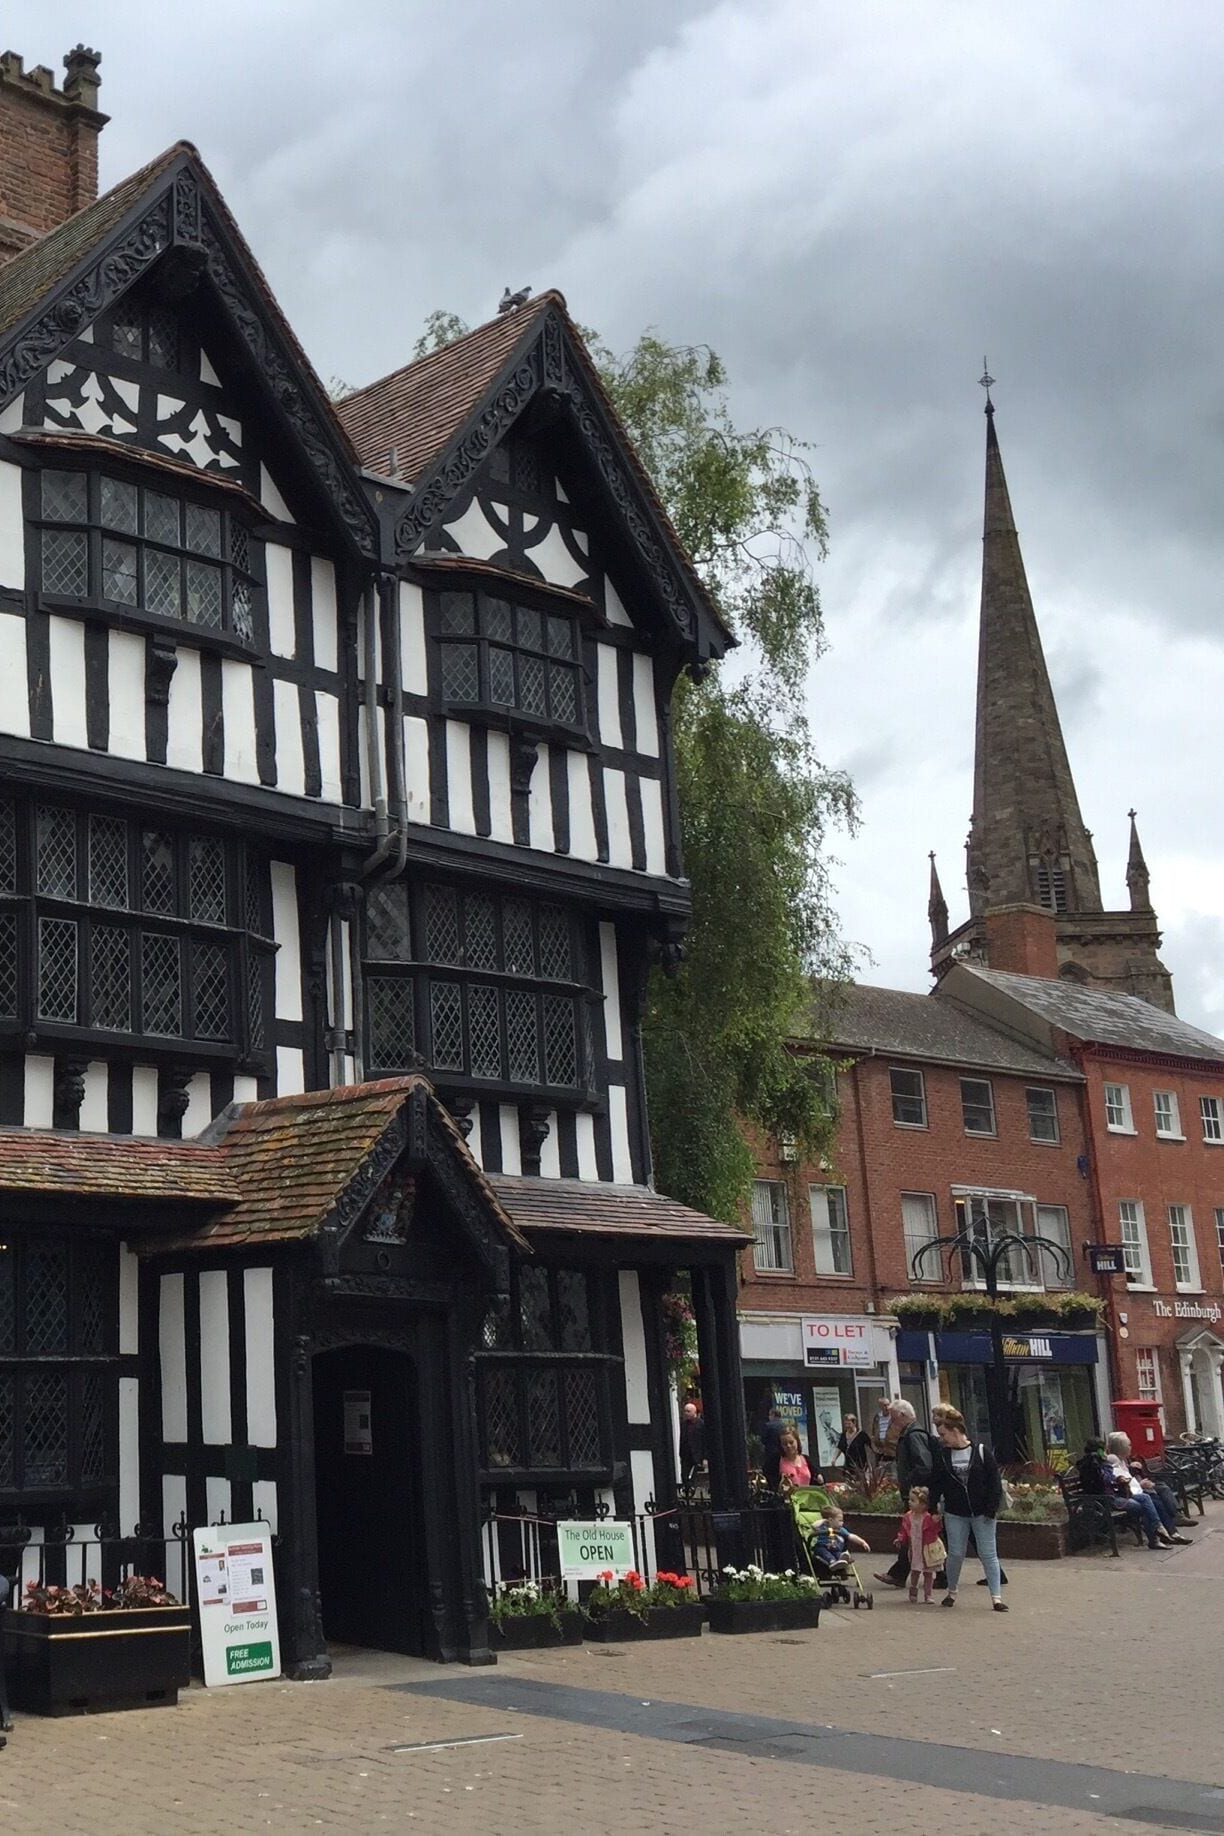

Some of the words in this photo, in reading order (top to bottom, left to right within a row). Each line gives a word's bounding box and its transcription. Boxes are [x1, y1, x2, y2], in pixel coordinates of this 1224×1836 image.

[1097, 1260, 1117, 1271] HILL
[1153, 1300, 1172, 1317] The
[1174, 1302, 1222, 1323] Edinburgh
[807, 1324, 829, 1337] TO
[835, 1325, 865, 1337] LET
[1029, 1338, 1053, 1357] HILL
[775, 1392, 802, 1405] WE'VE
[776, 1406, 803, 1417] MOVED
[565, 1529, 580, 1540] The
[582, 1529, 597, 1540] Old
[599, 1530, 625, 1541] House
[579, 1545, 614, 1560] OPEN
[224, 1623, 244, 1633] Open
[246, 1620, 268, 1630] Today
[229, 1648, 249, 1660] FREE
[230, 1656, 270, 1671] ADMISSION
